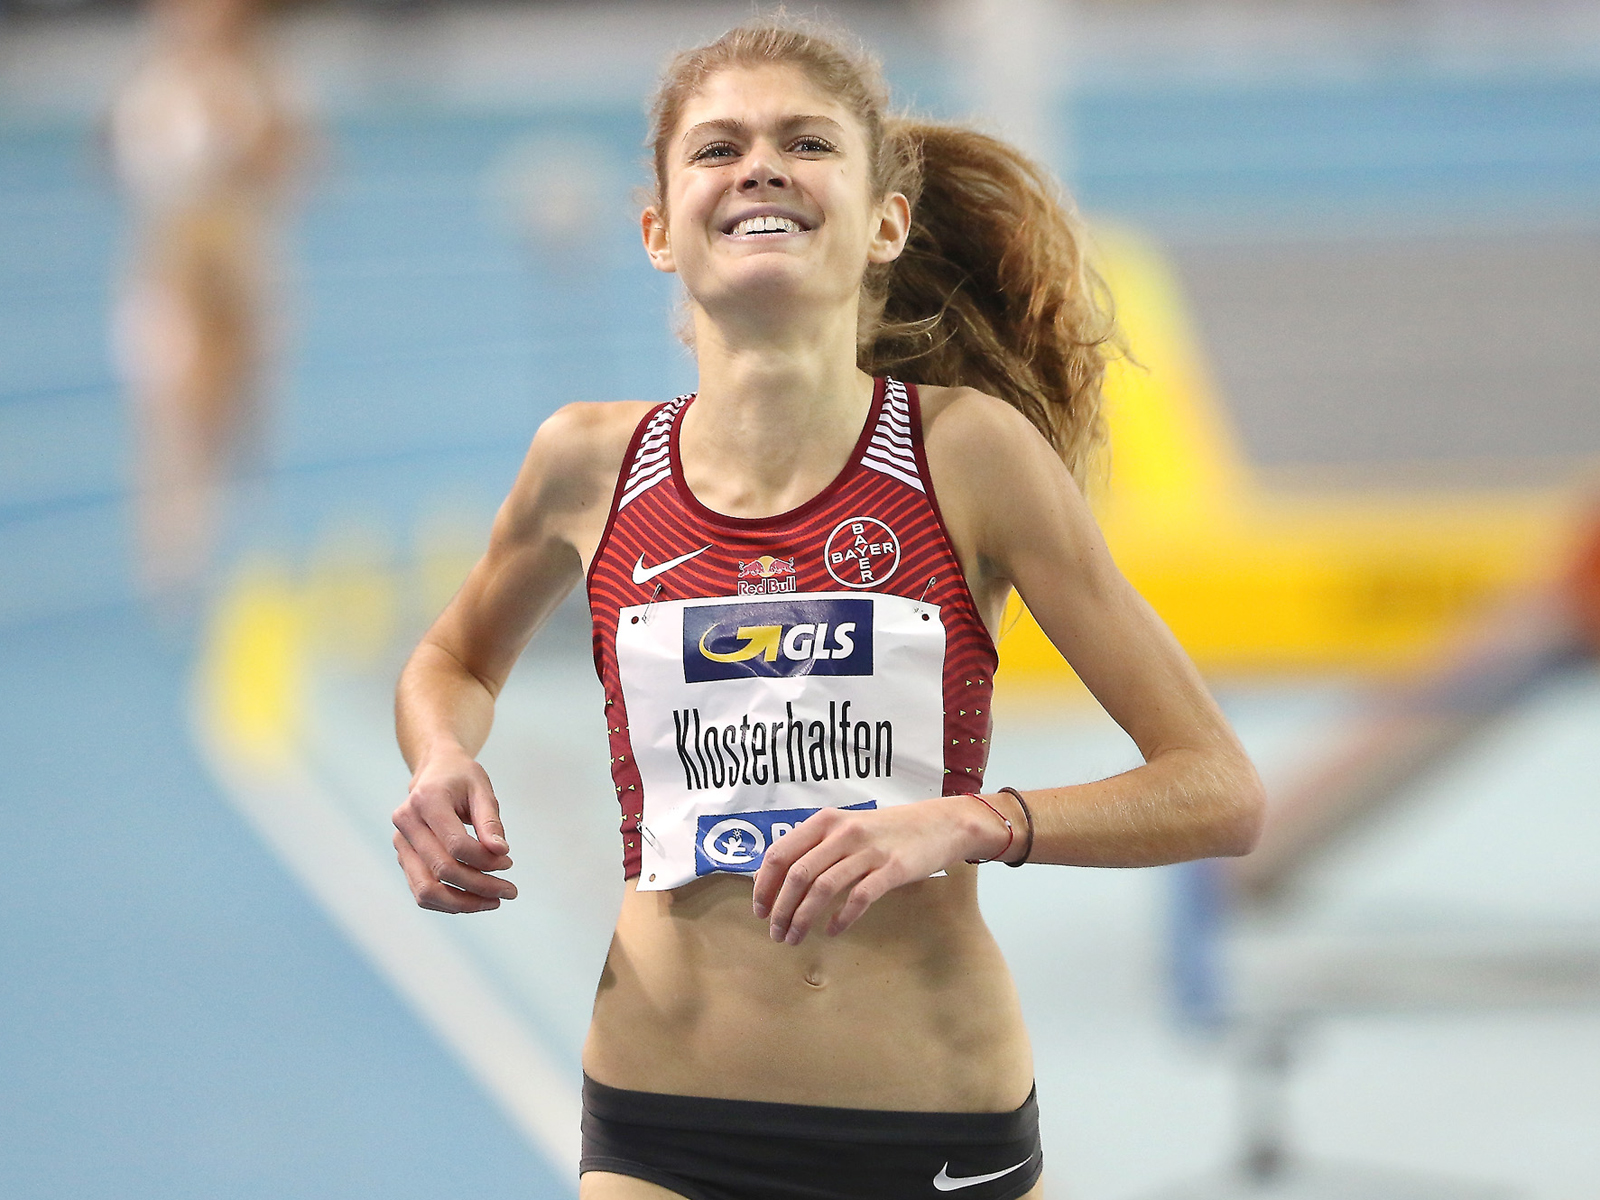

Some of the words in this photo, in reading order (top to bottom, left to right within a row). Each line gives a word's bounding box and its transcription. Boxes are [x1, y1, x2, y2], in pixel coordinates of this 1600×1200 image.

[831, 542, 894, 564] BAYER
[852, 523, 875, 582] BAYER
[738, 578, 767, 596] Red
[768, 576, 796, 593] Bull
[783, 622, 856, 661] GLS
[672, 700, 893, 790] Klosterhalfen
